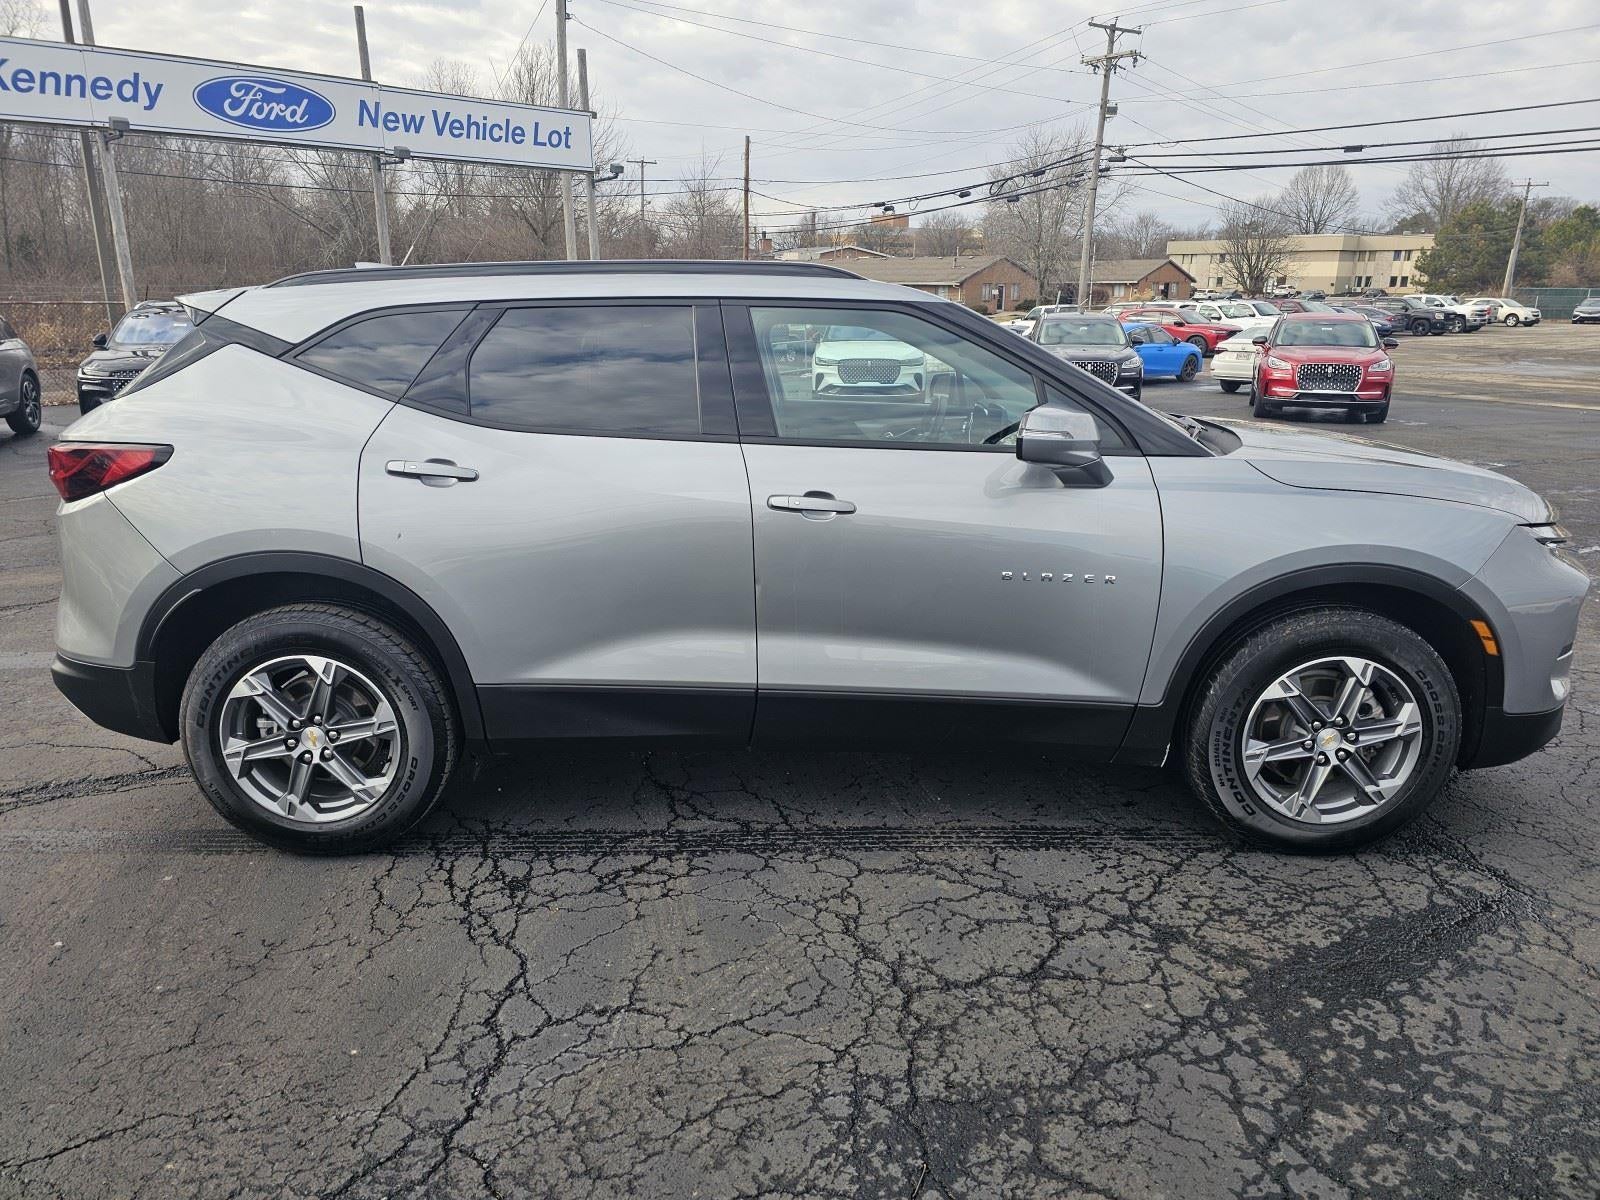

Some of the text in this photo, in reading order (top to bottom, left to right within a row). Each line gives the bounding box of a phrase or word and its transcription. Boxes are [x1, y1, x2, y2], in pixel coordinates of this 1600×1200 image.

[223, 80, 310, 124] Ford
[358, 99, 425, 134] New
[431, 109, 526, 145] Vehicle
[532, 121, 572, 149] Lot
[1001, 571, 1116, 585] BLAZER
